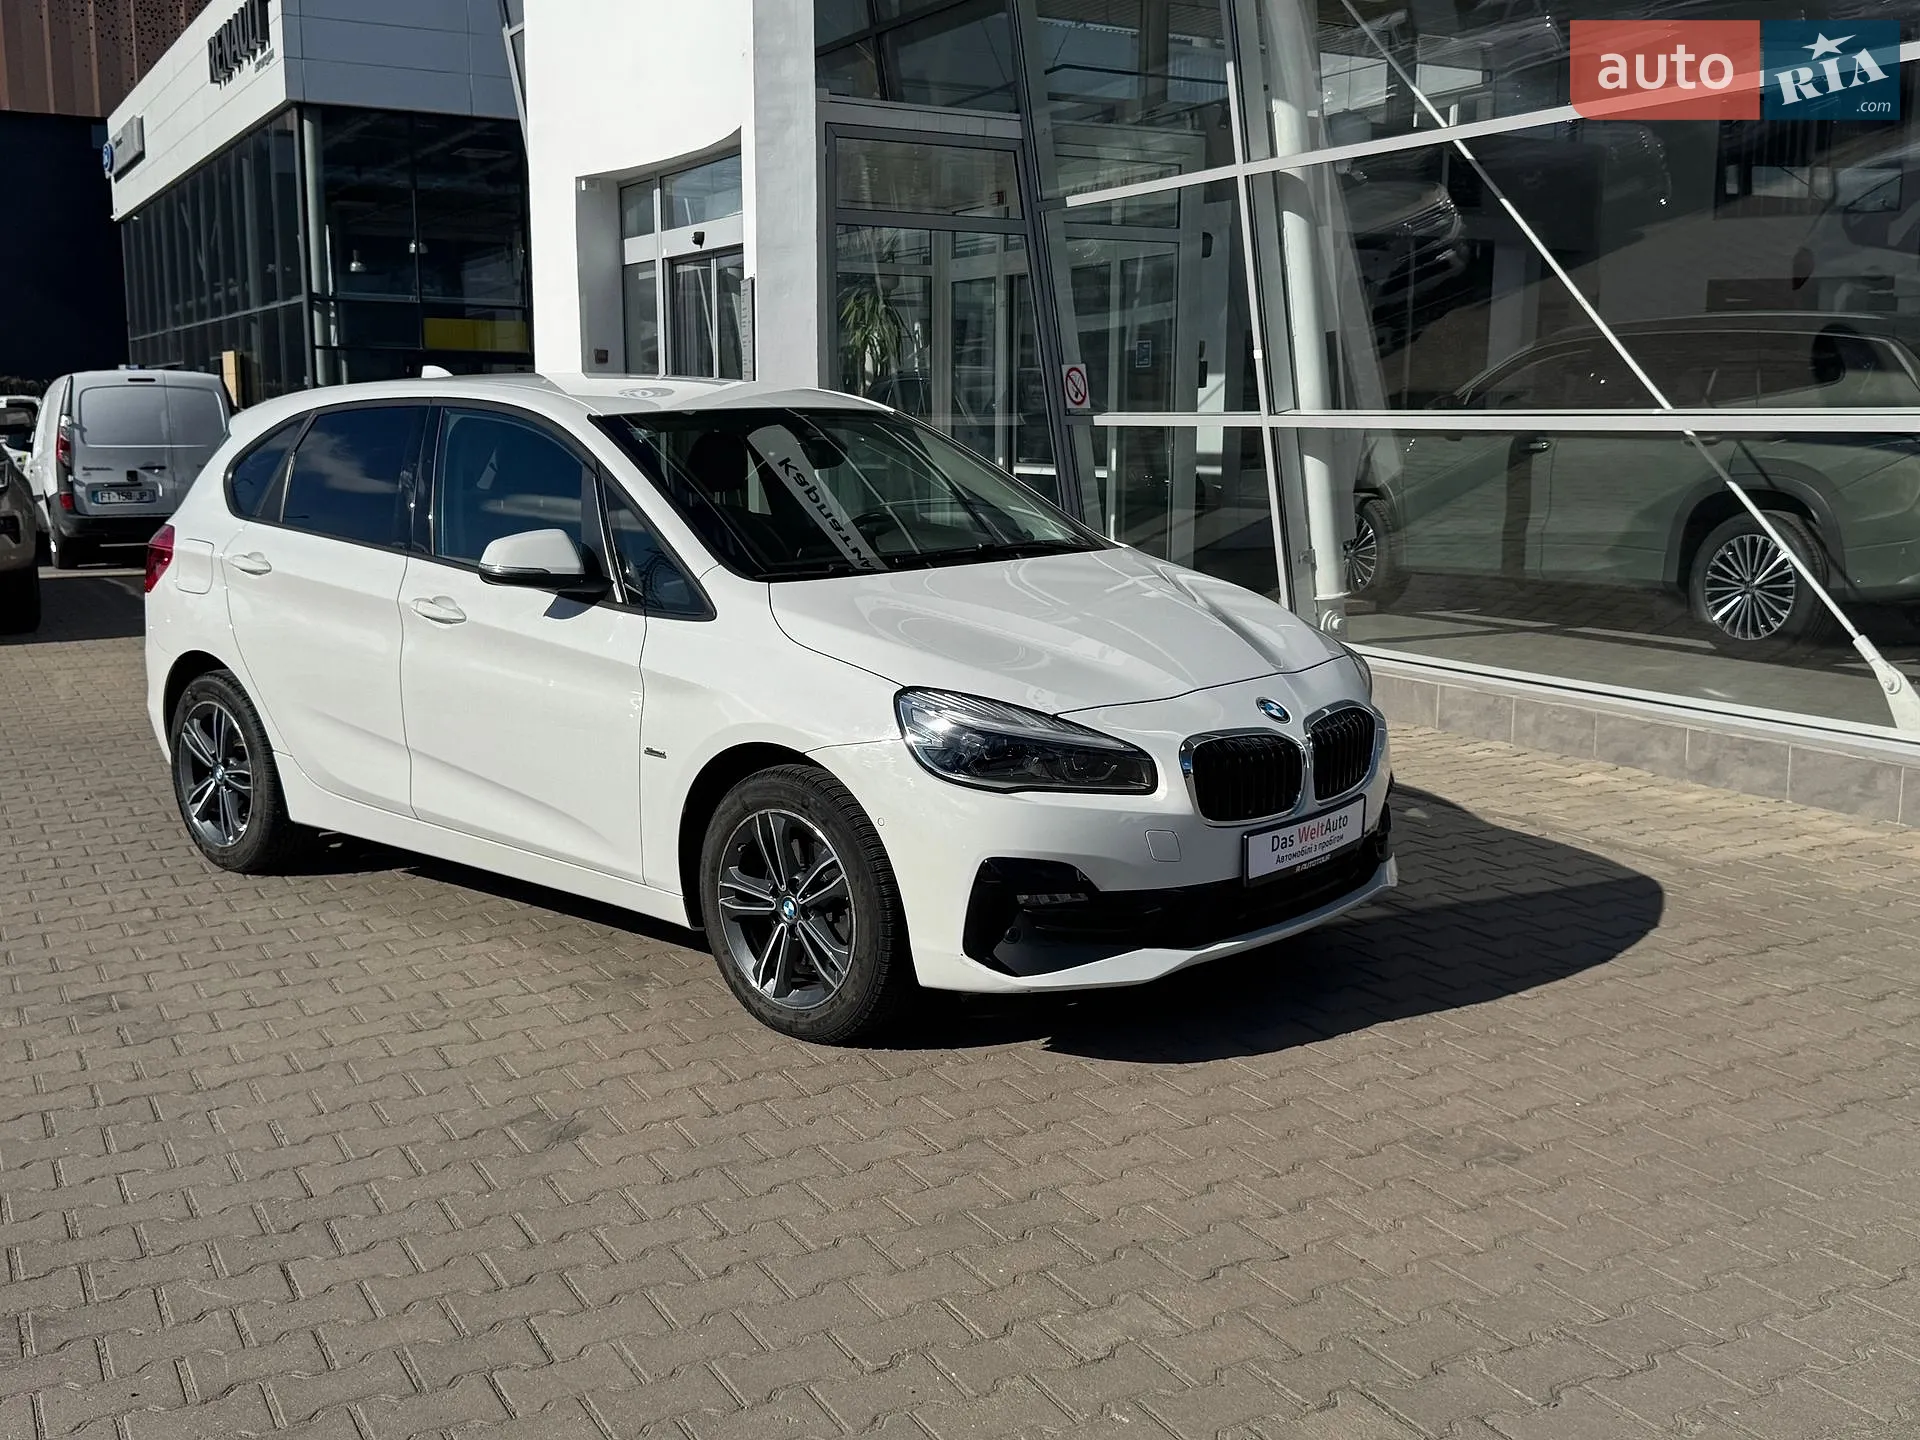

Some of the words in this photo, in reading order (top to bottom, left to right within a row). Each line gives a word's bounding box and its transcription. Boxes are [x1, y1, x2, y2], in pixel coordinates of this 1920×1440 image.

[1271, 835, 1295, 852] Das
[1298, 815, 1348, 844] WeltAuto
[1275, 846, 1314, 865] Автомобілі
[1318, 834, 1344, 851] пробігом
